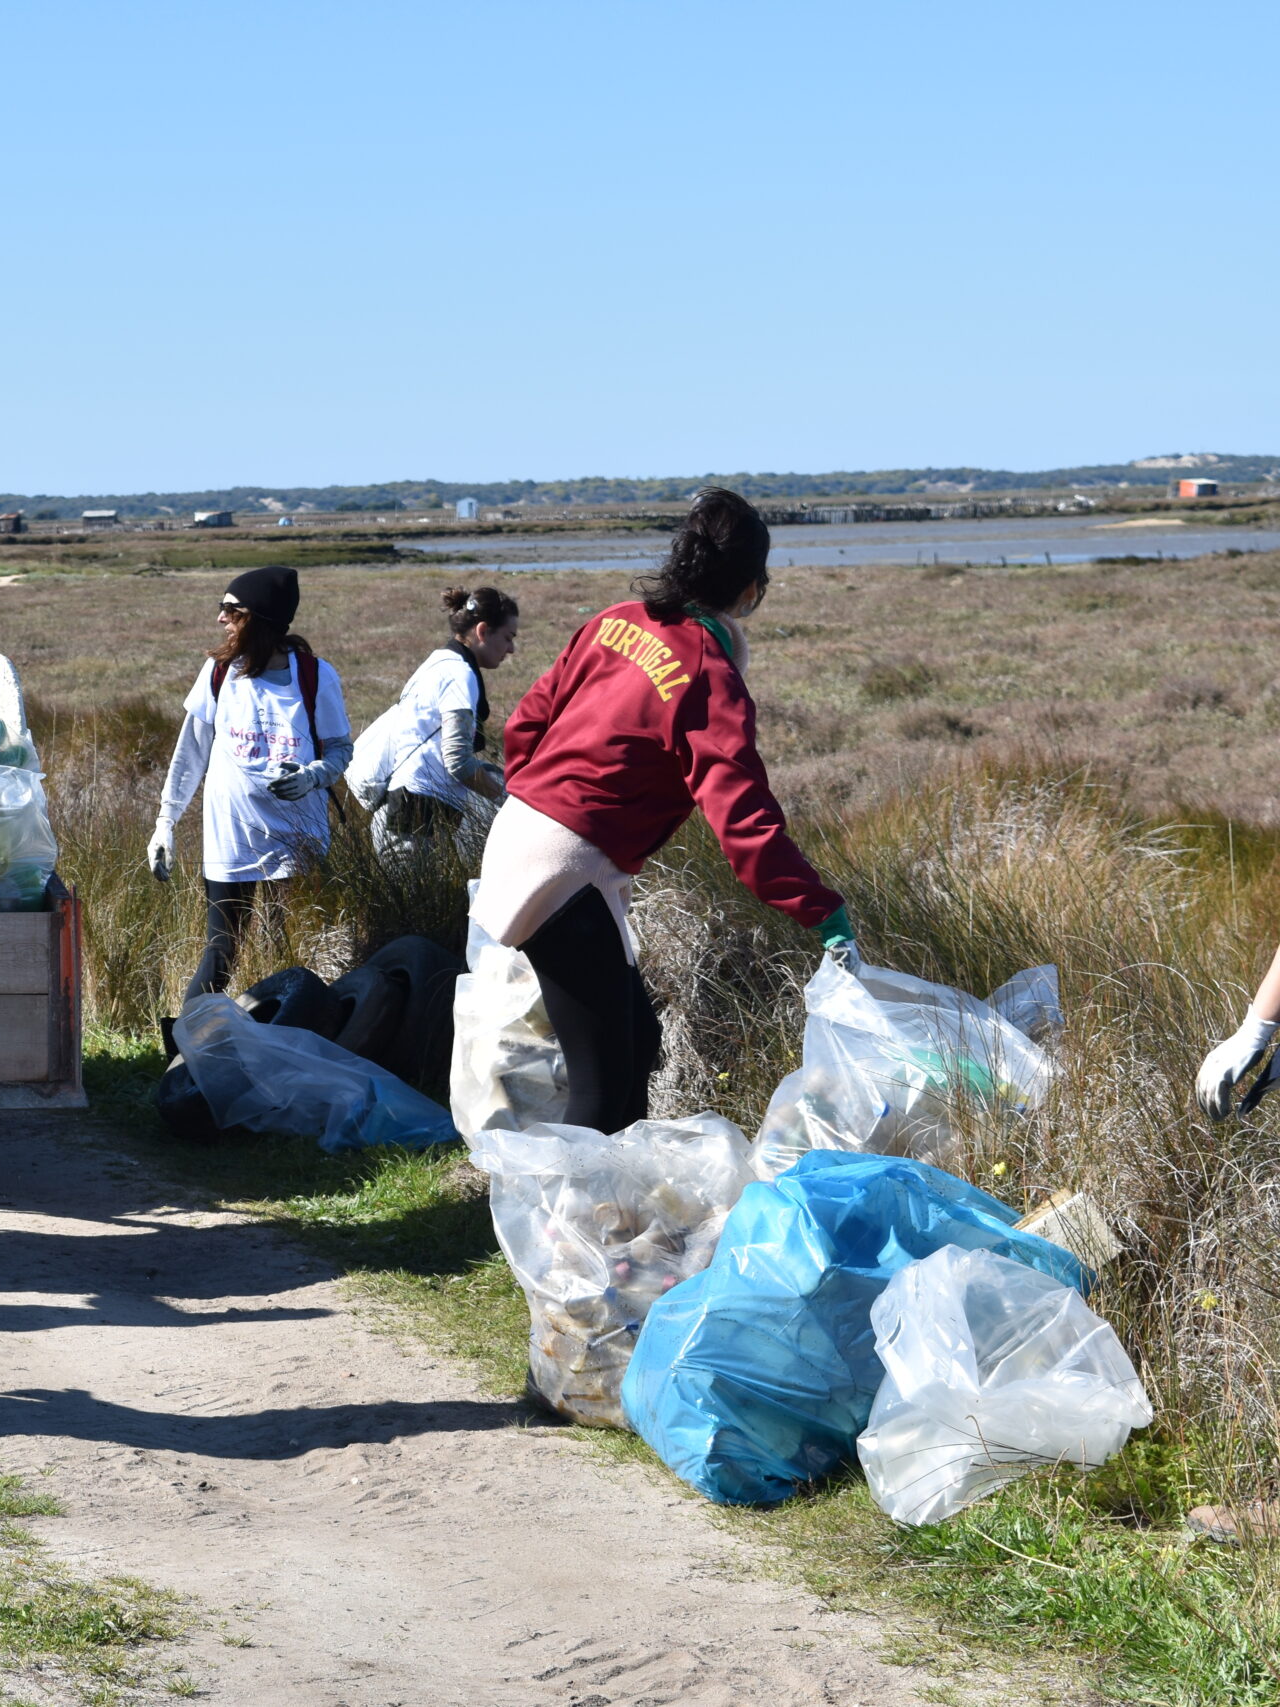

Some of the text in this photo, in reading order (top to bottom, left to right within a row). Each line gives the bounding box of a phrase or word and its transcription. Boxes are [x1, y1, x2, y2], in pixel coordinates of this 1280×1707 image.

[592, 618, 690, 702] PORTUGAL
[231, 727, 301, 747] Mariscar
[234, 745, 261, 759] SEM
